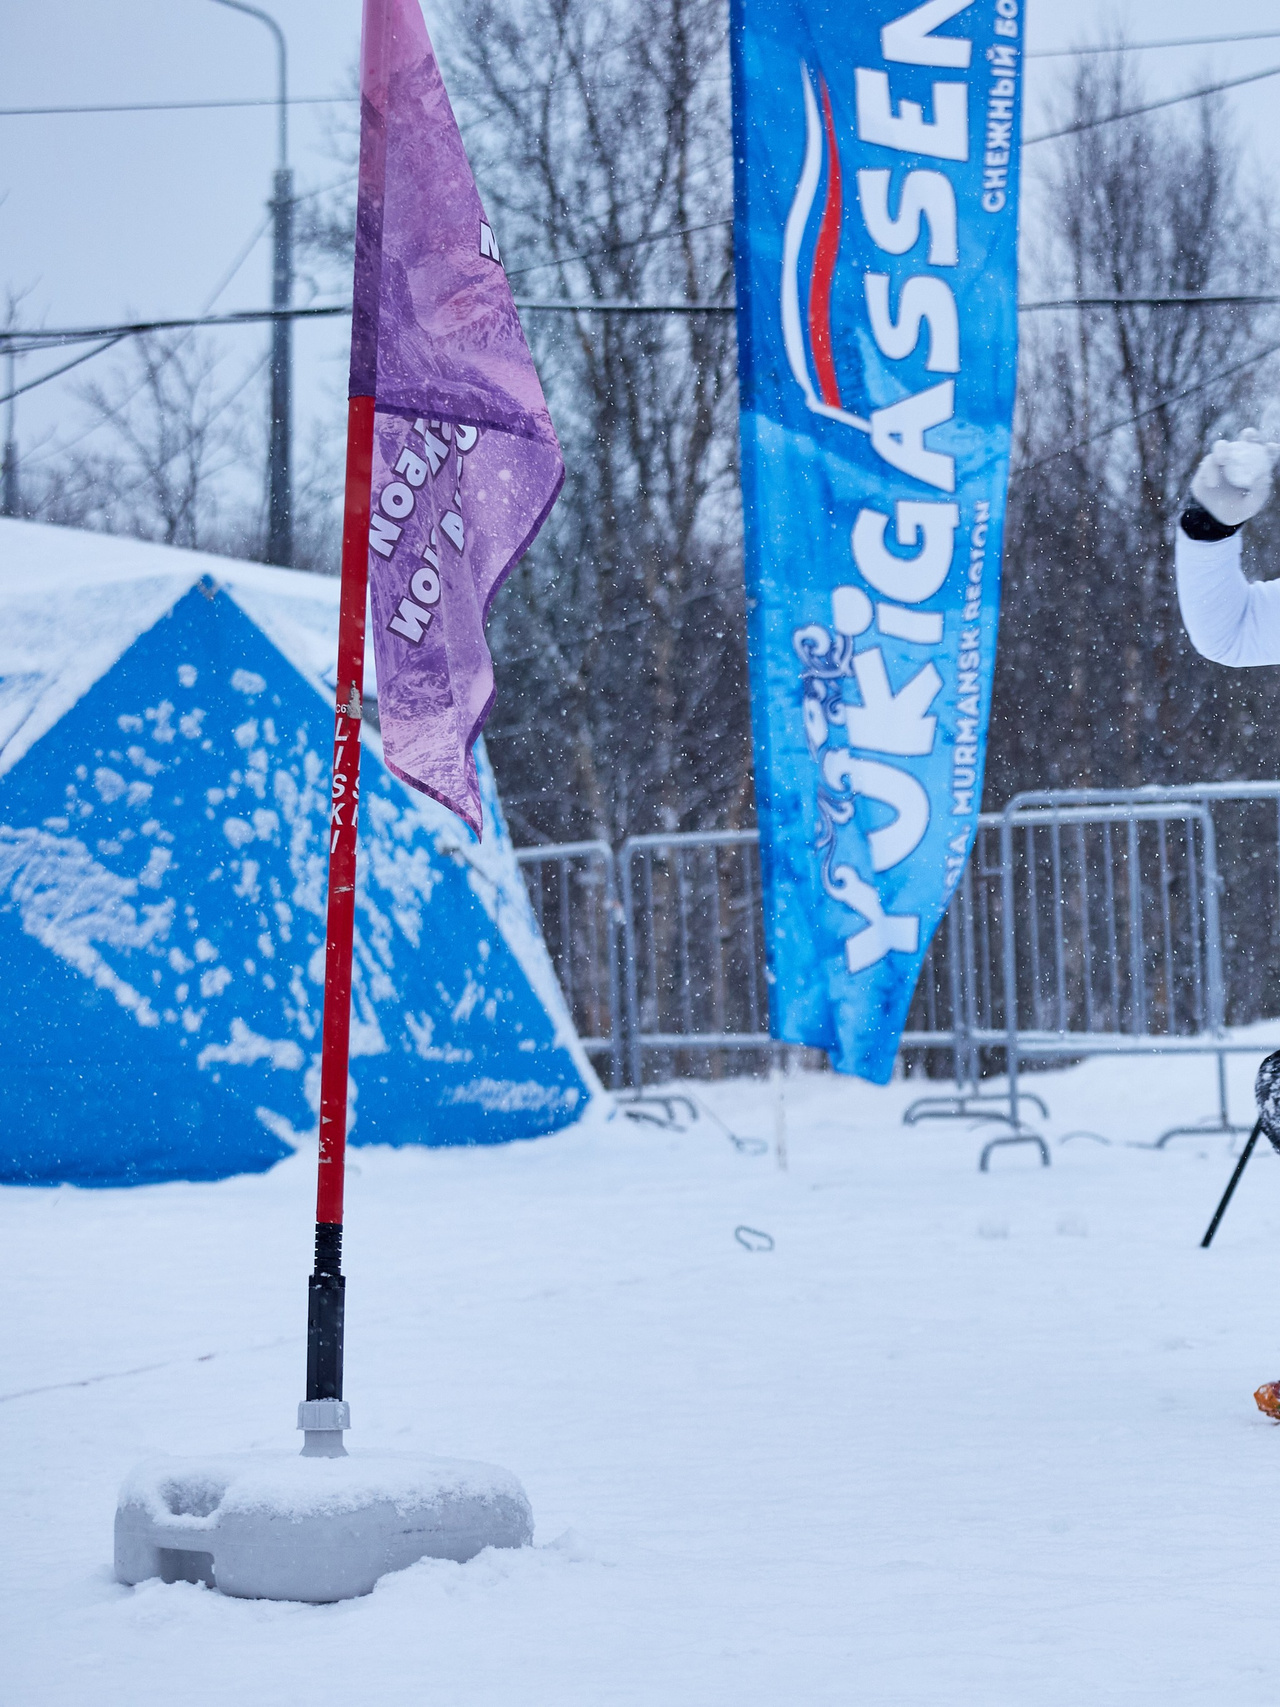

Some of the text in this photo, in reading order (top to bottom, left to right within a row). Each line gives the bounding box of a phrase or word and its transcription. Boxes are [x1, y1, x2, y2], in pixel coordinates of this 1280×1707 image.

[982, 0, 1018, 213] СНЕЖНЫЙ БО
[330, 717, 348, 855] LISKI
[952, 628, 982, 815] MURMANSK
